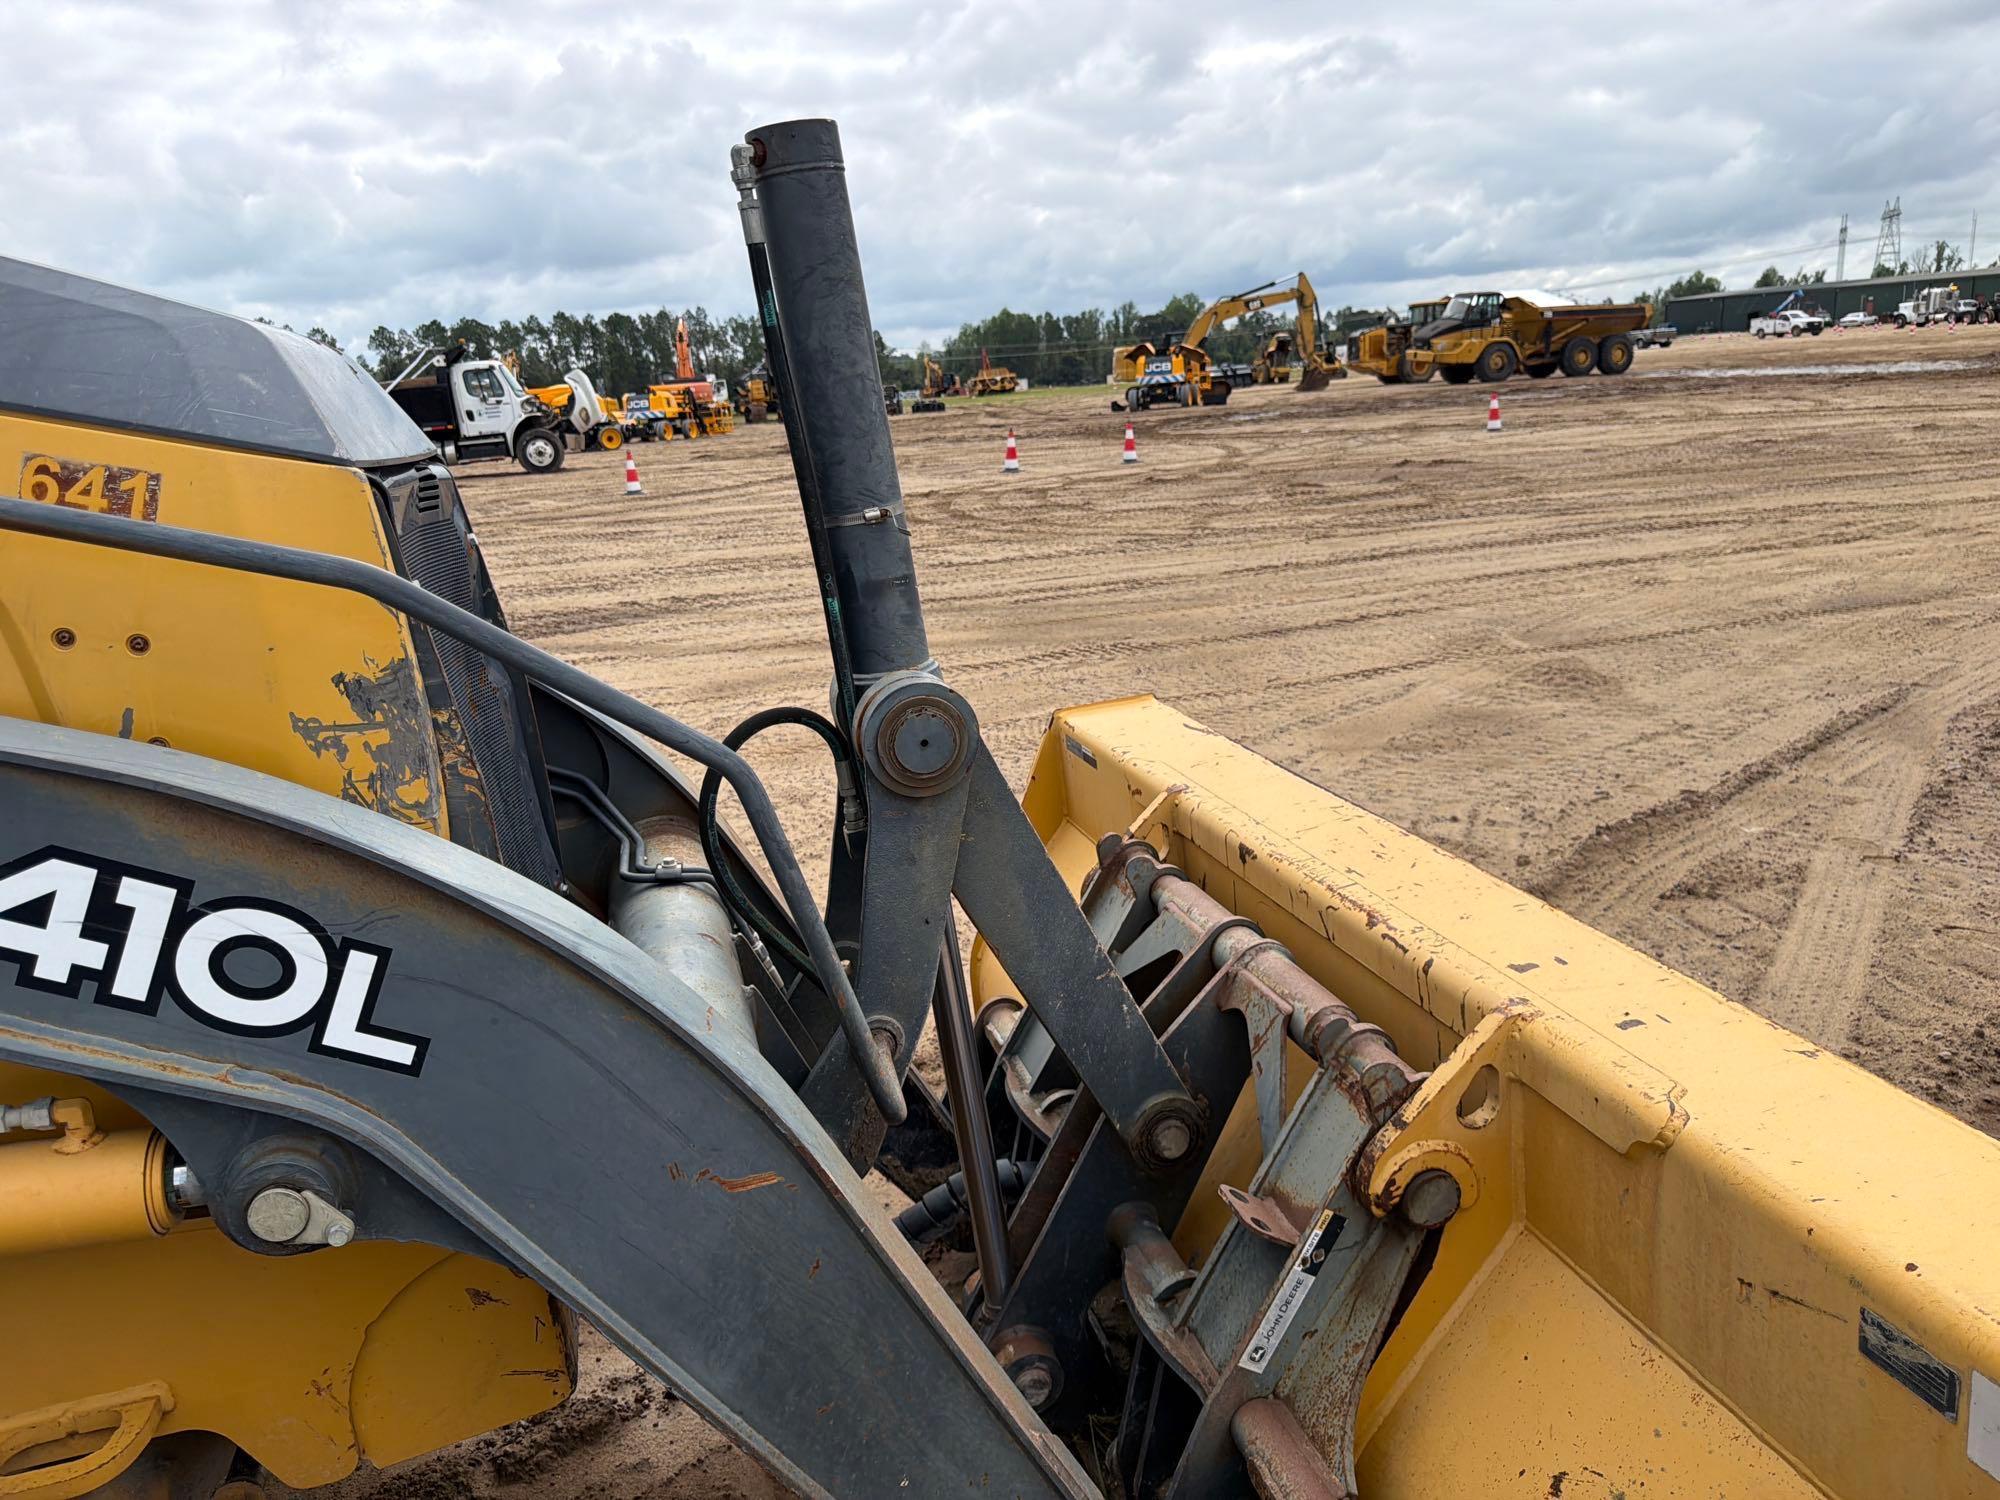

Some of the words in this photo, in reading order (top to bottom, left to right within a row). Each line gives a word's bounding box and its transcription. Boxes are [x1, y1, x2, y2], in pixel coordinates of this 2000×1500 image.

[1145, 362, 1172, 373] JCB
[627, 400, 649, 409] JCB
[20, 456, 148, 521] 641
[0, 857, 418, 1067] 410L
[1318, 1213, 1330, 1230] PRO
[1264, 1313, 1284, 1344] JOHN
[1279, 1277, 1304, 1313] DEERE
